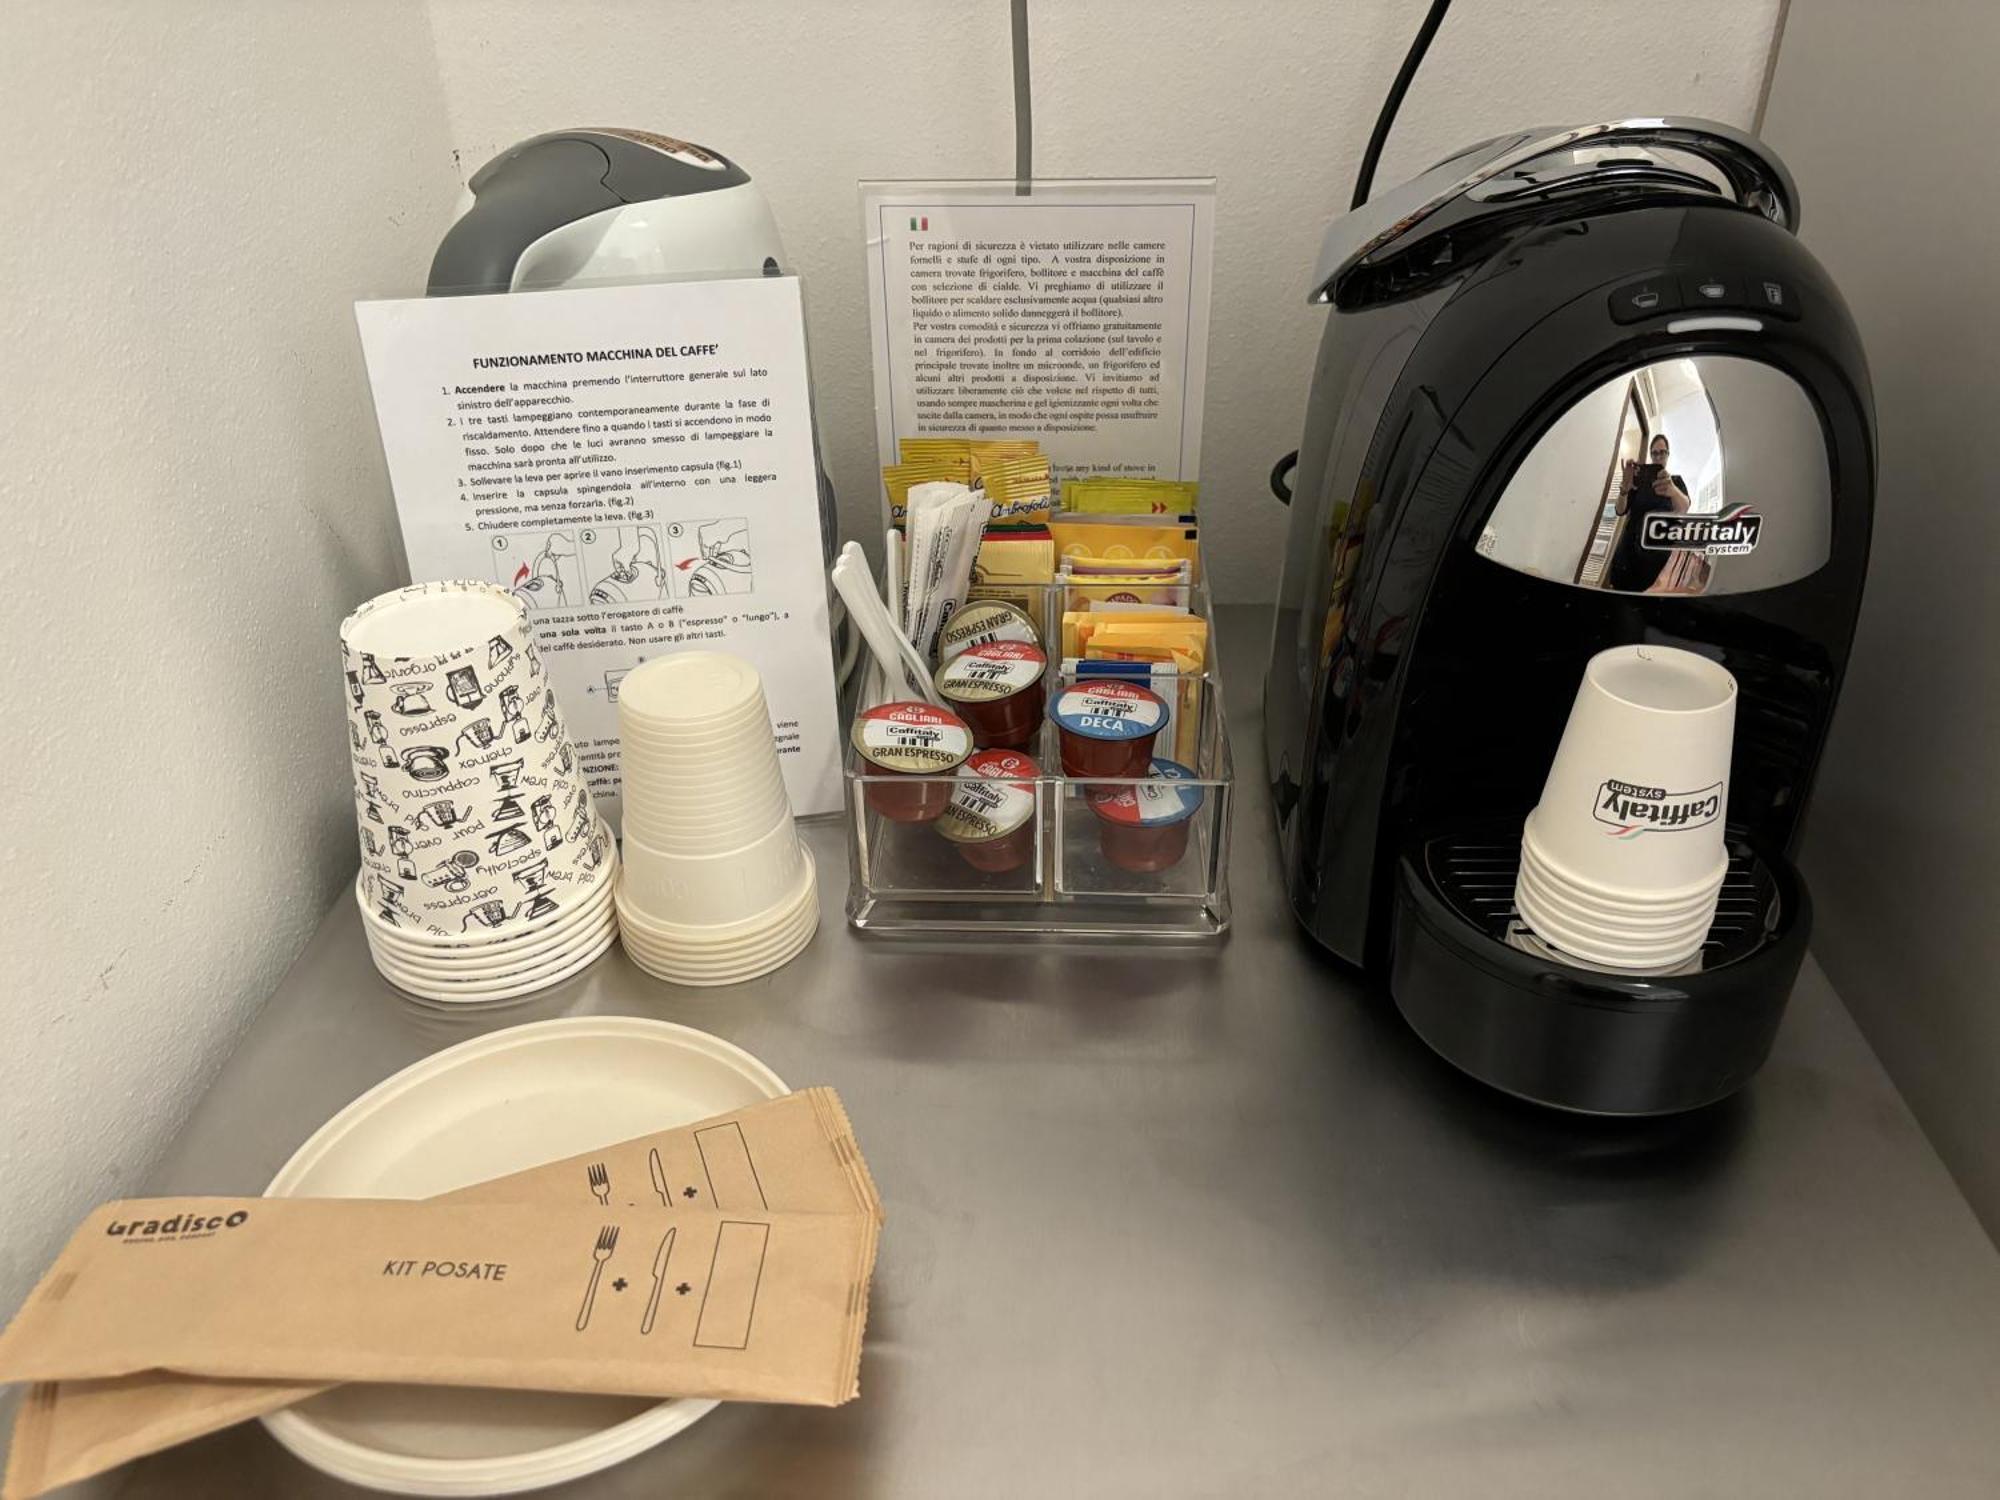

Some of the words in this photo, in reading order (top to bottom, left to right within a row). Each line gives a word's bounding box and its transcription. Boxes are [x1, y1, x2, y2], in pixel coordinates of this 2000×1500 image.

[909, 241, 924, 251] Per
[928, 241, 959, 252] ragioni
[975, 242, 1017, 250] sicurezza
[1029, 242, 1060, 250] vietato
[1063, 241, 1104, 250] utilizzare
[1108, 241, 1130, 250] nelle
[910, 255, 942, 264] fornelli
[957, 255, 978, 264] stufe
[997, 255, 1017, 266] ogni
[1096, 254, 1152, 265] disposizione
[1030, 268, 1068, 277] bollitore
[1080, 268, 1122, 277] macchina
[1125, 268, 1139, 277] del
[1142, 268, 1165, 277] caffè
[933, 282, 973, 291] selezione
[1044, 282, 1091, 292] preghiamo
[1111, 281, 1152, 290] utilizzare
[473, 353, 584, 368] FUNZIONAMENTO
[586, 349, 653, 361] MACCHINA
[656, 347, 678, 358] DEL
[680, 344, 719, 356] CAFFE'
[455, 385, 506, 394] Accendere
[523, 381, 568, 390] macchina
[572, 377, 621, 388] premendo
[689, 370, 729, 382] generale
[733, 369, 746, 378] sul
[750, 368, 768, 377] lato
[457, 401, 492, 410] sinistro
[468, 417, 483, 425] tre
[487, 415, 509, 424] tasti
[513, 412, 573, 422] lampeggiano
[578, 405, 680, 418] contemporaneamente
[684, 402, 721, 411] durante
[738, 399, 757, 408] fase
[495, 445, 516, 454] Solo
[521, 444, 545, 453] dopo
[551, 442, 568, 450] che
[587, 440, 604, 448] luci
[609, 438, 647, 446] avranno
[652, 435, 686, 443] smesso
[705, 431, 760, 440] lampeggiare
[468, 461, 512, 471] macchina
[514, 459, 534, 468] sarà
[535, 458, 567, 468] pronta
[470, 477, 512, 486] Sollevare
[525, 474, 544, 482] leva
[546, 474, 562, 482] per
[564, 471, 591, 480] aprire
[600, 469, 624, 477] vano
[625, 466, 680, 475] inserimento
[681, 462, 714, 472] capsula
[478, 521, 519, 530] Chiudere
[521, 516, 593, 527] completamente
[1649, 520, 1756, 544] Caffitaly
[1707, 545, 1750, 554] system
[986, 610, 1013, 628] GRAN
[946, 622, 986, 643] ESPRESSO
[385, 662, 437, 679] organic
[943, 679, 968, 689] GRAN
[968, 680, 1012, 695] ESPRESSO
[1084, 698, 1134, 711] Caffitaly
[400, 713, 457, 737] espresso
[889, 712, 942, 724] CAGLIARI
[1080, 716, 1124, 732] DECA
[889, 726, 940, 738] Caffitaly
[459, 747, 513, 769] chemex
[872, 746, 904, 758] GRAN
[905, 747, 954, 764] ESPRESSO
[402, 776, 480, 799] cappuccino
[1609, 780, 1664, 800] system
[1602, 791, 1718, 826] Caffitaly
[452, 819, 486, 842] pour
[956, 811, 997, 836] ESPRESSO
[413, 836, 442, 850] over
[423, 885, 498, 911] aeropress
[426, 924, 450, 937] old
[106, 1209, 249, 1237] Gradisco
[383, 1260, 418, 1277] KIT
[421, 1260, 508, 1281] POSATE
